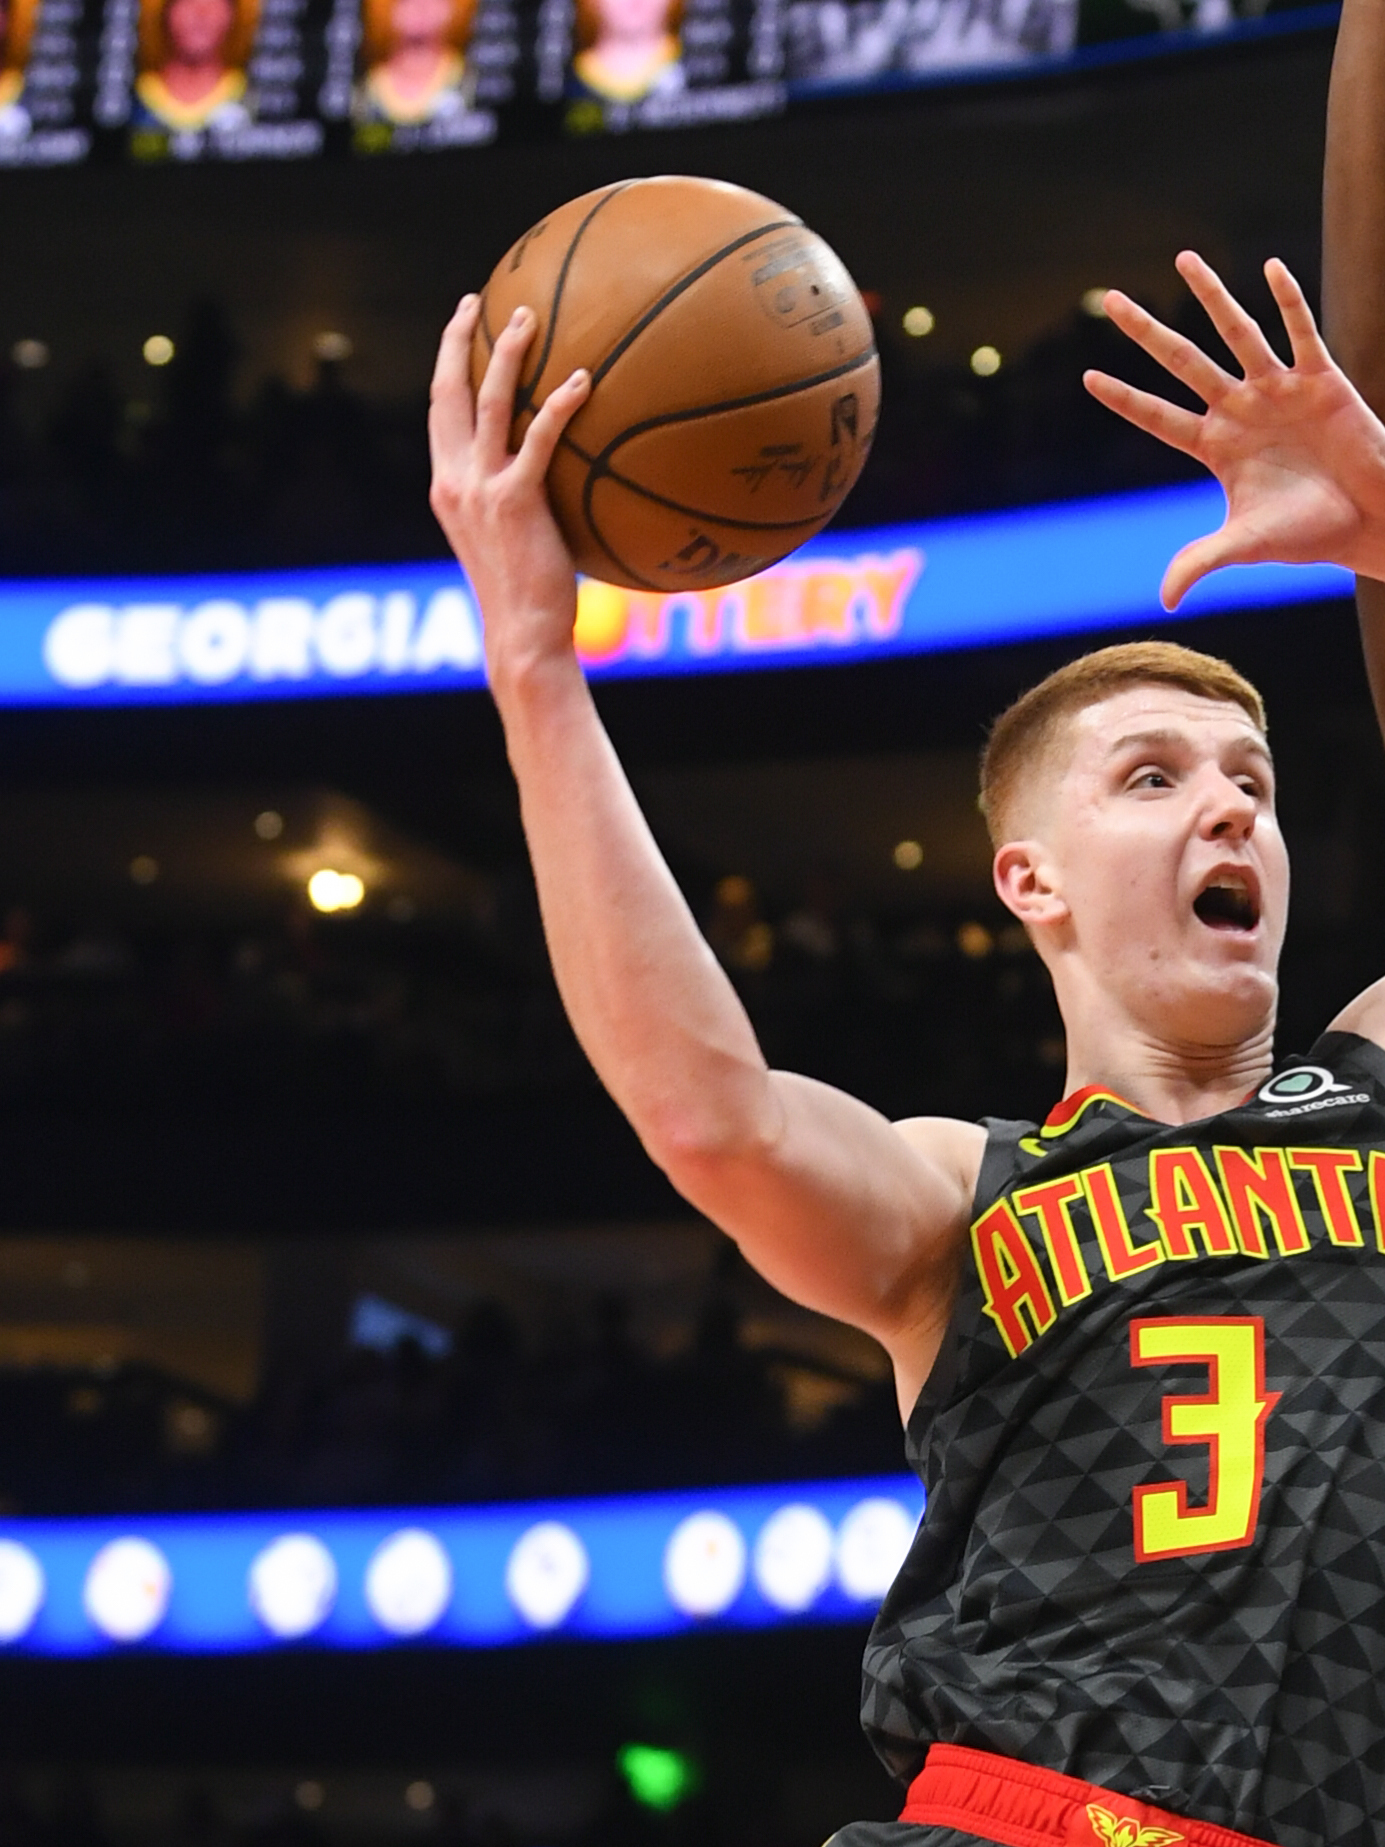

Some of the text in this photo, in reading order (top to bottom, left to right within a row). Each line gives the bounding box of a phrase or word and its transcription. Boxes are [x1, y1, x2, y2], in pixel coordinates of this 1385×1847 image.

[43, 586, 480, 689] GEORGIA
[1264, 1093, 1371, 1118] sharecare
[1129, 1315, 1282, 1564] 3
